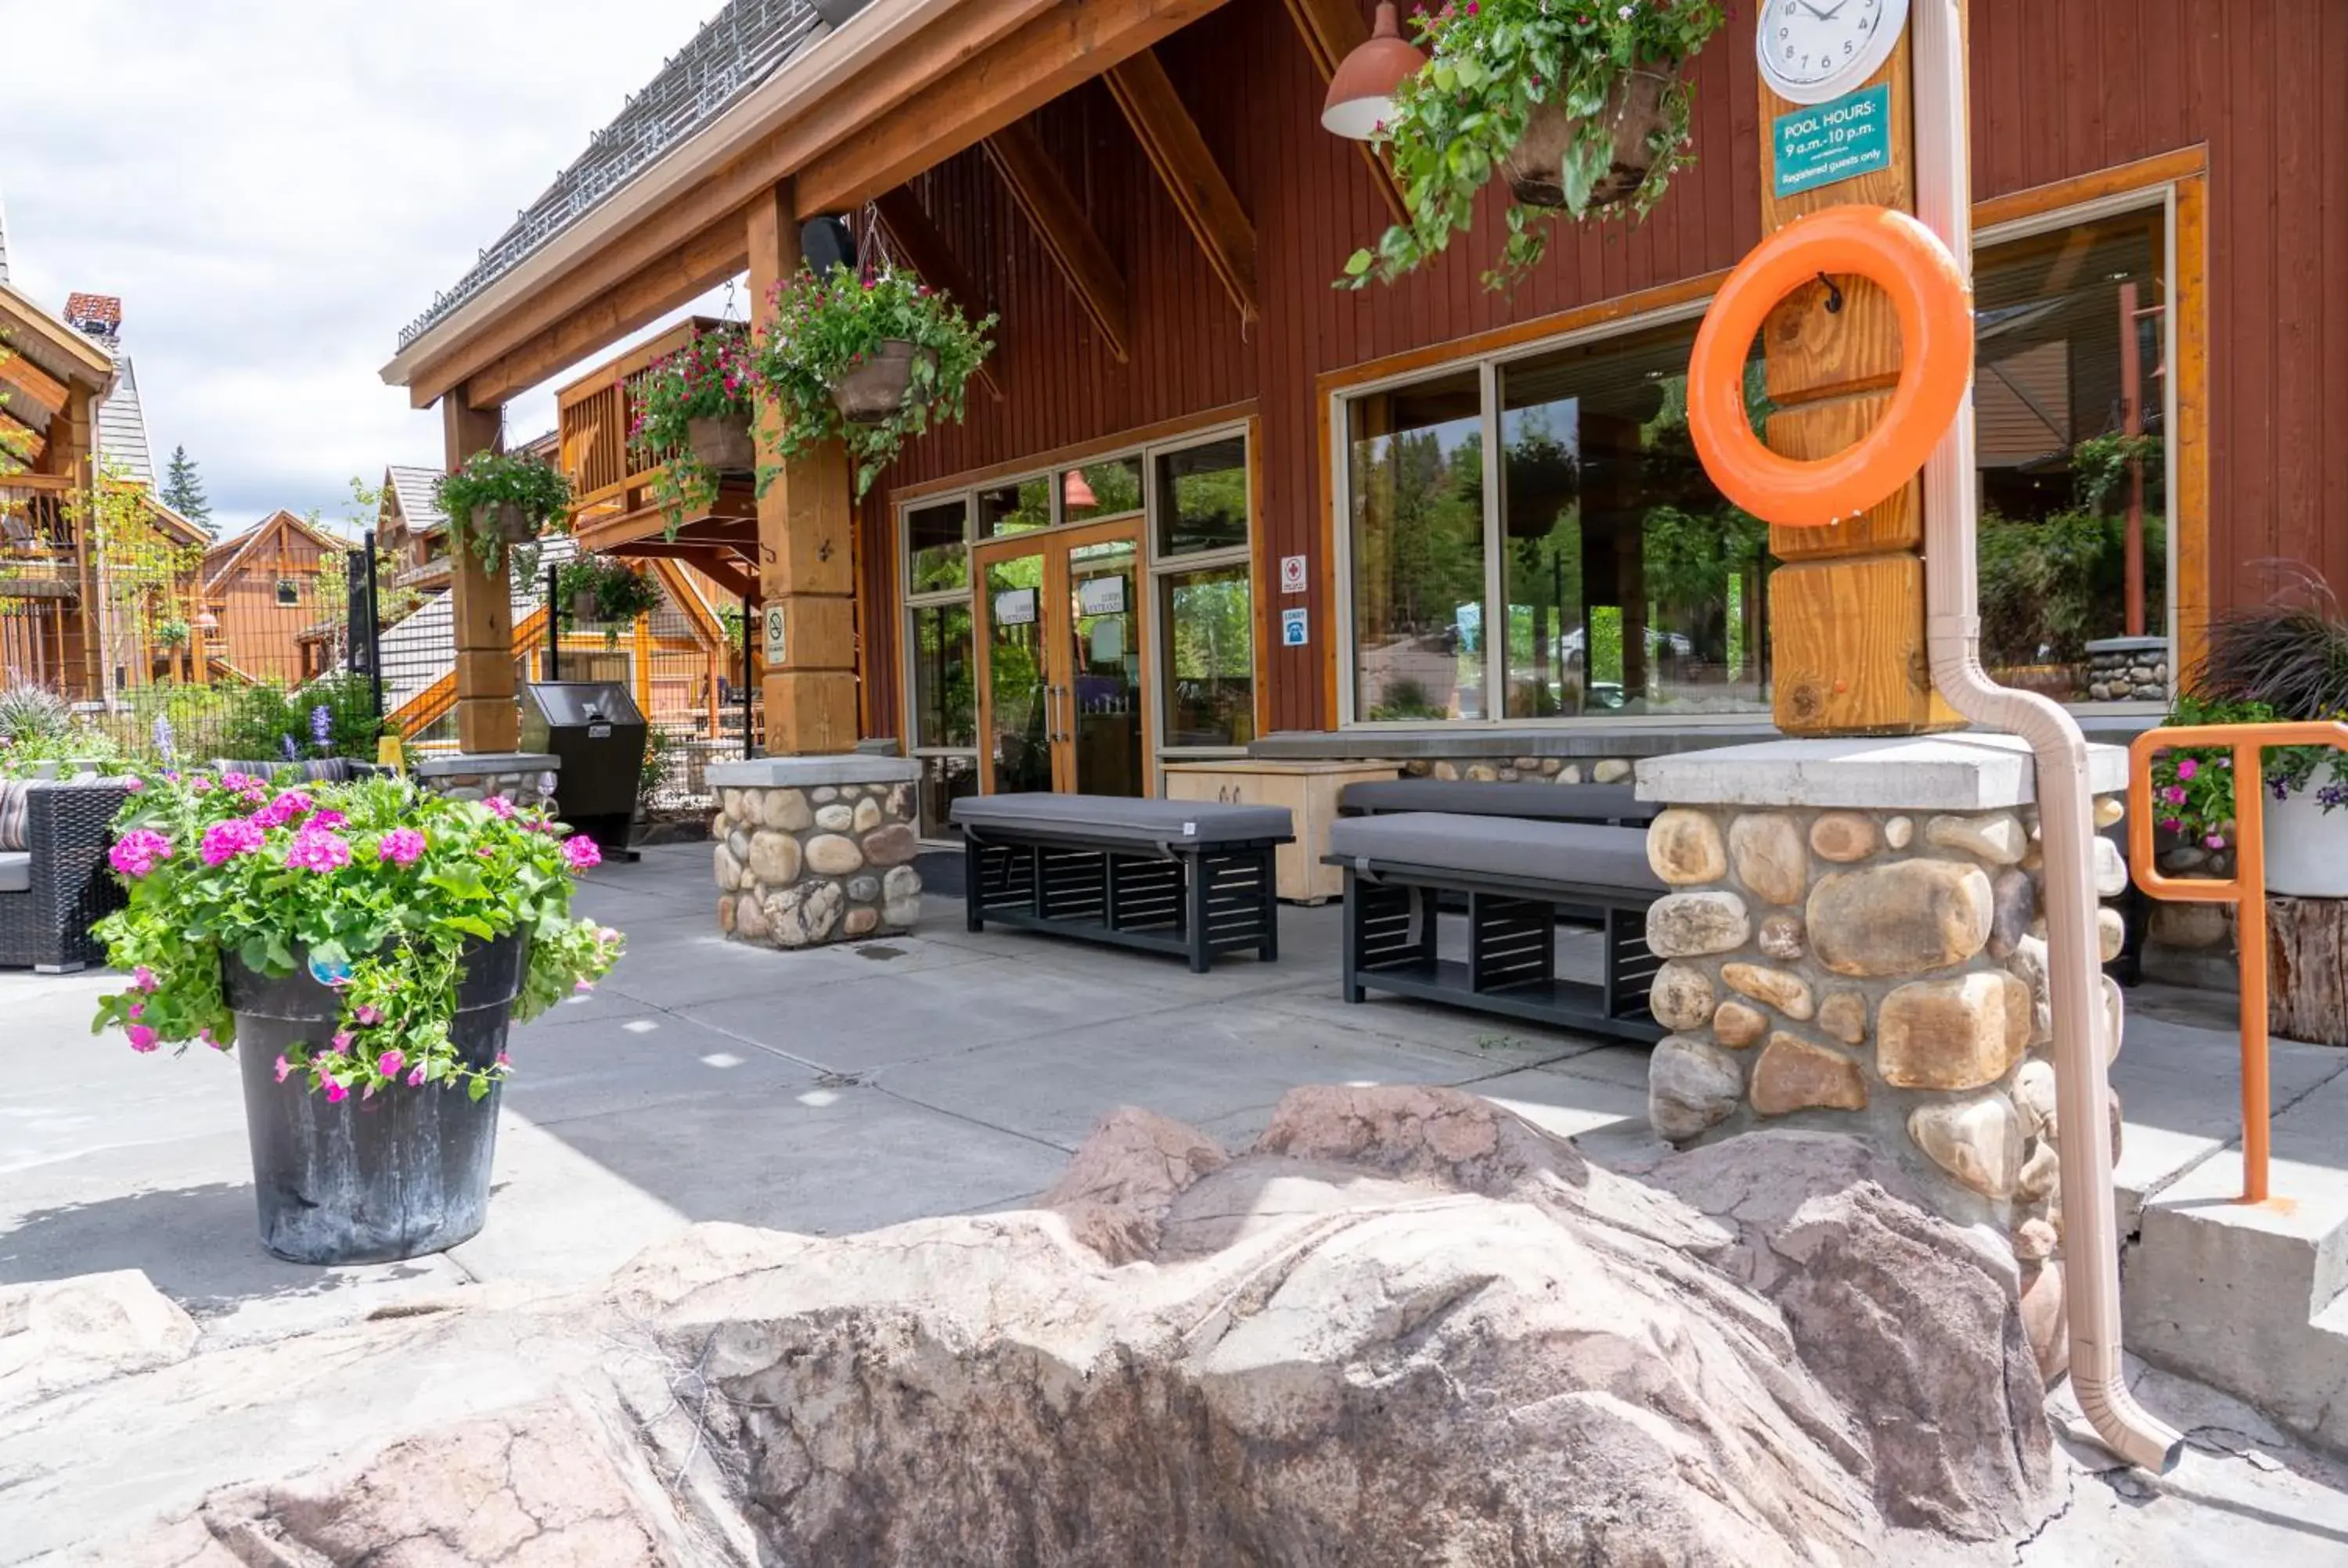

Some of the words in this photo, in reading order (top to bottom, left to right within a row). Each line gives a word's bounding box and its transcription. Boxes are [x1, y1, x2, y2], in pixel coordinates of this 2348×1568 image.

[1785, 2, 1796, 16] 10
[1858, 16, 1867, 30] 4
[1780, 27, 1788, 40] 9
[1785, 45, 1794, 59] 8
[1844, 40, 1853, 54] 5
[1801, 53, 1809, 69] 7
[1821, 56, 1831, 69] 6
[1784, 117, 1820, 139] POOL
[1823, 100, 1876, 128] HOURS:
[1785, 143, 1795, 157] 9
[1846, 124, 1875, 142] p.m.
[1783, 162, 1828, 184] Registered
[1829, 155, 1859, 173] guests
[1860, 148, 1881, 163] only
